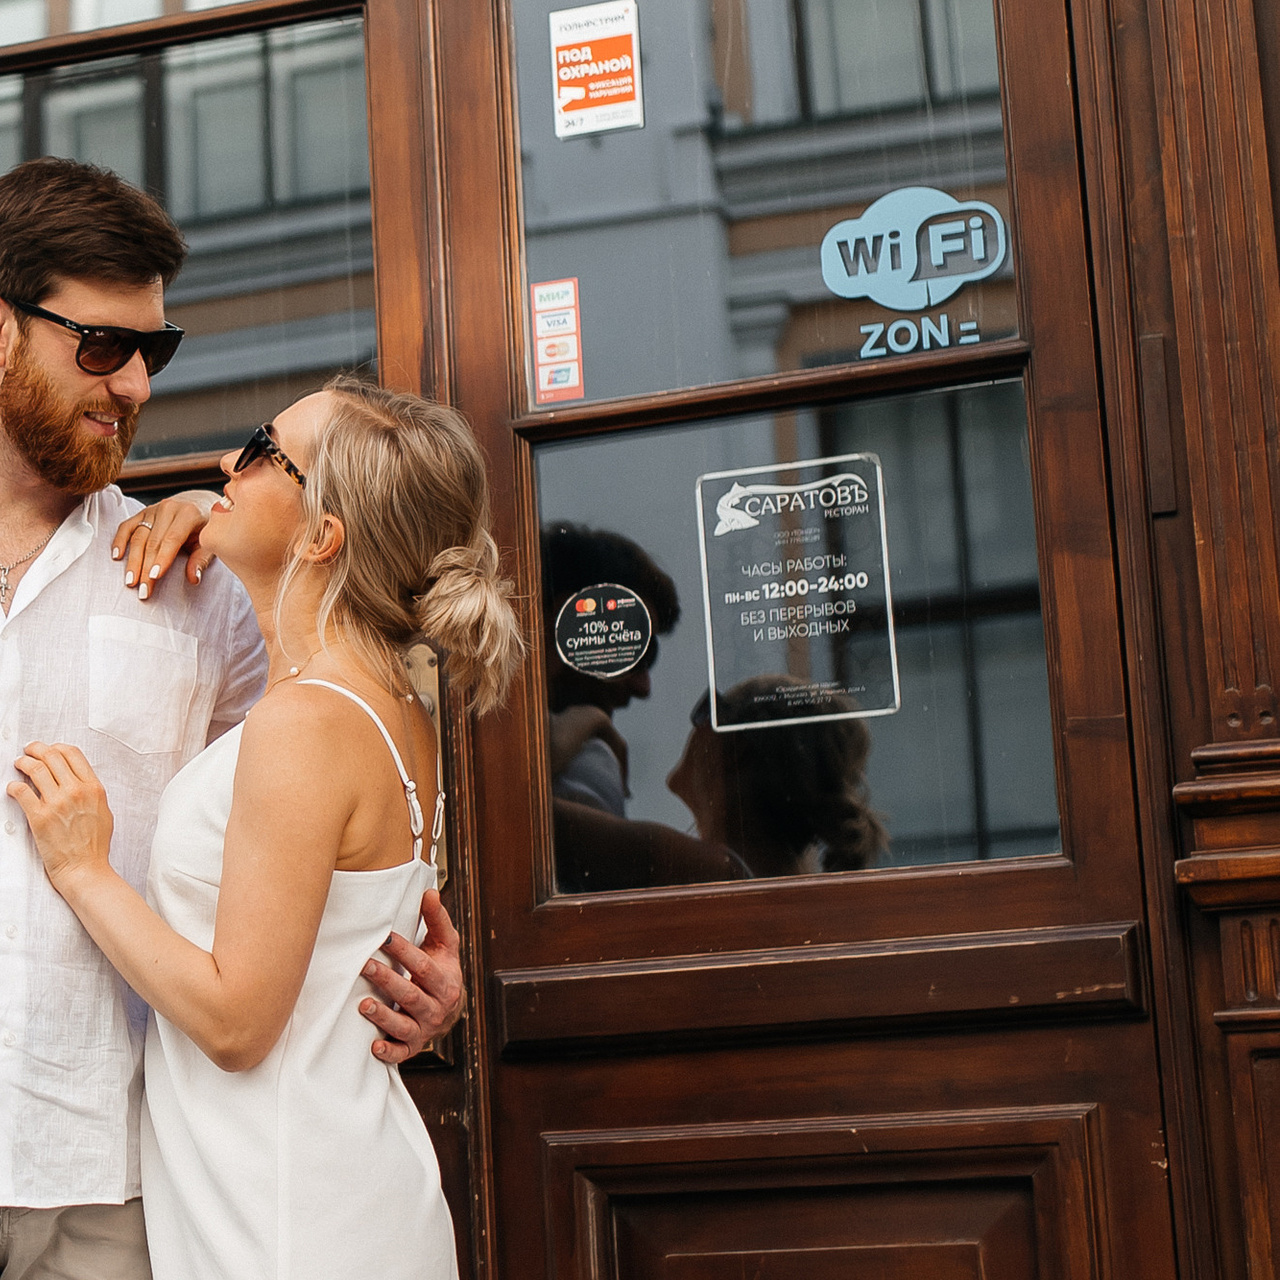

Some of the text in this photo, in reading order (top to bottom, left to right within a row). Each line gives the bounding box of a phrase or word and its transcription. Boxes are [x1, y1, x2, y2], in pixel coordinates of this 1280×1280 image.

[558, 46, 592, 64] ПОД
[558, 54, 631, 81] ОХРАНОЙ
[546, 317, 568, 328] VISA
[745, 484, 869, 517] САРАТОВЪ
[824, 504, 869, 519] РЕСТОРАН
[741, 553, 848, 578] ЧАСЫ РАБОТЫ:
[761, 571, 869, 600] 12:00-24:00
[740, 599, 857, 626] БЕЗ ПЕРЕРЫВОВ
[566, 629, 642, 650] суммы счёта
[753, 618, 850, 643] И ВЫХОДНЫХ
